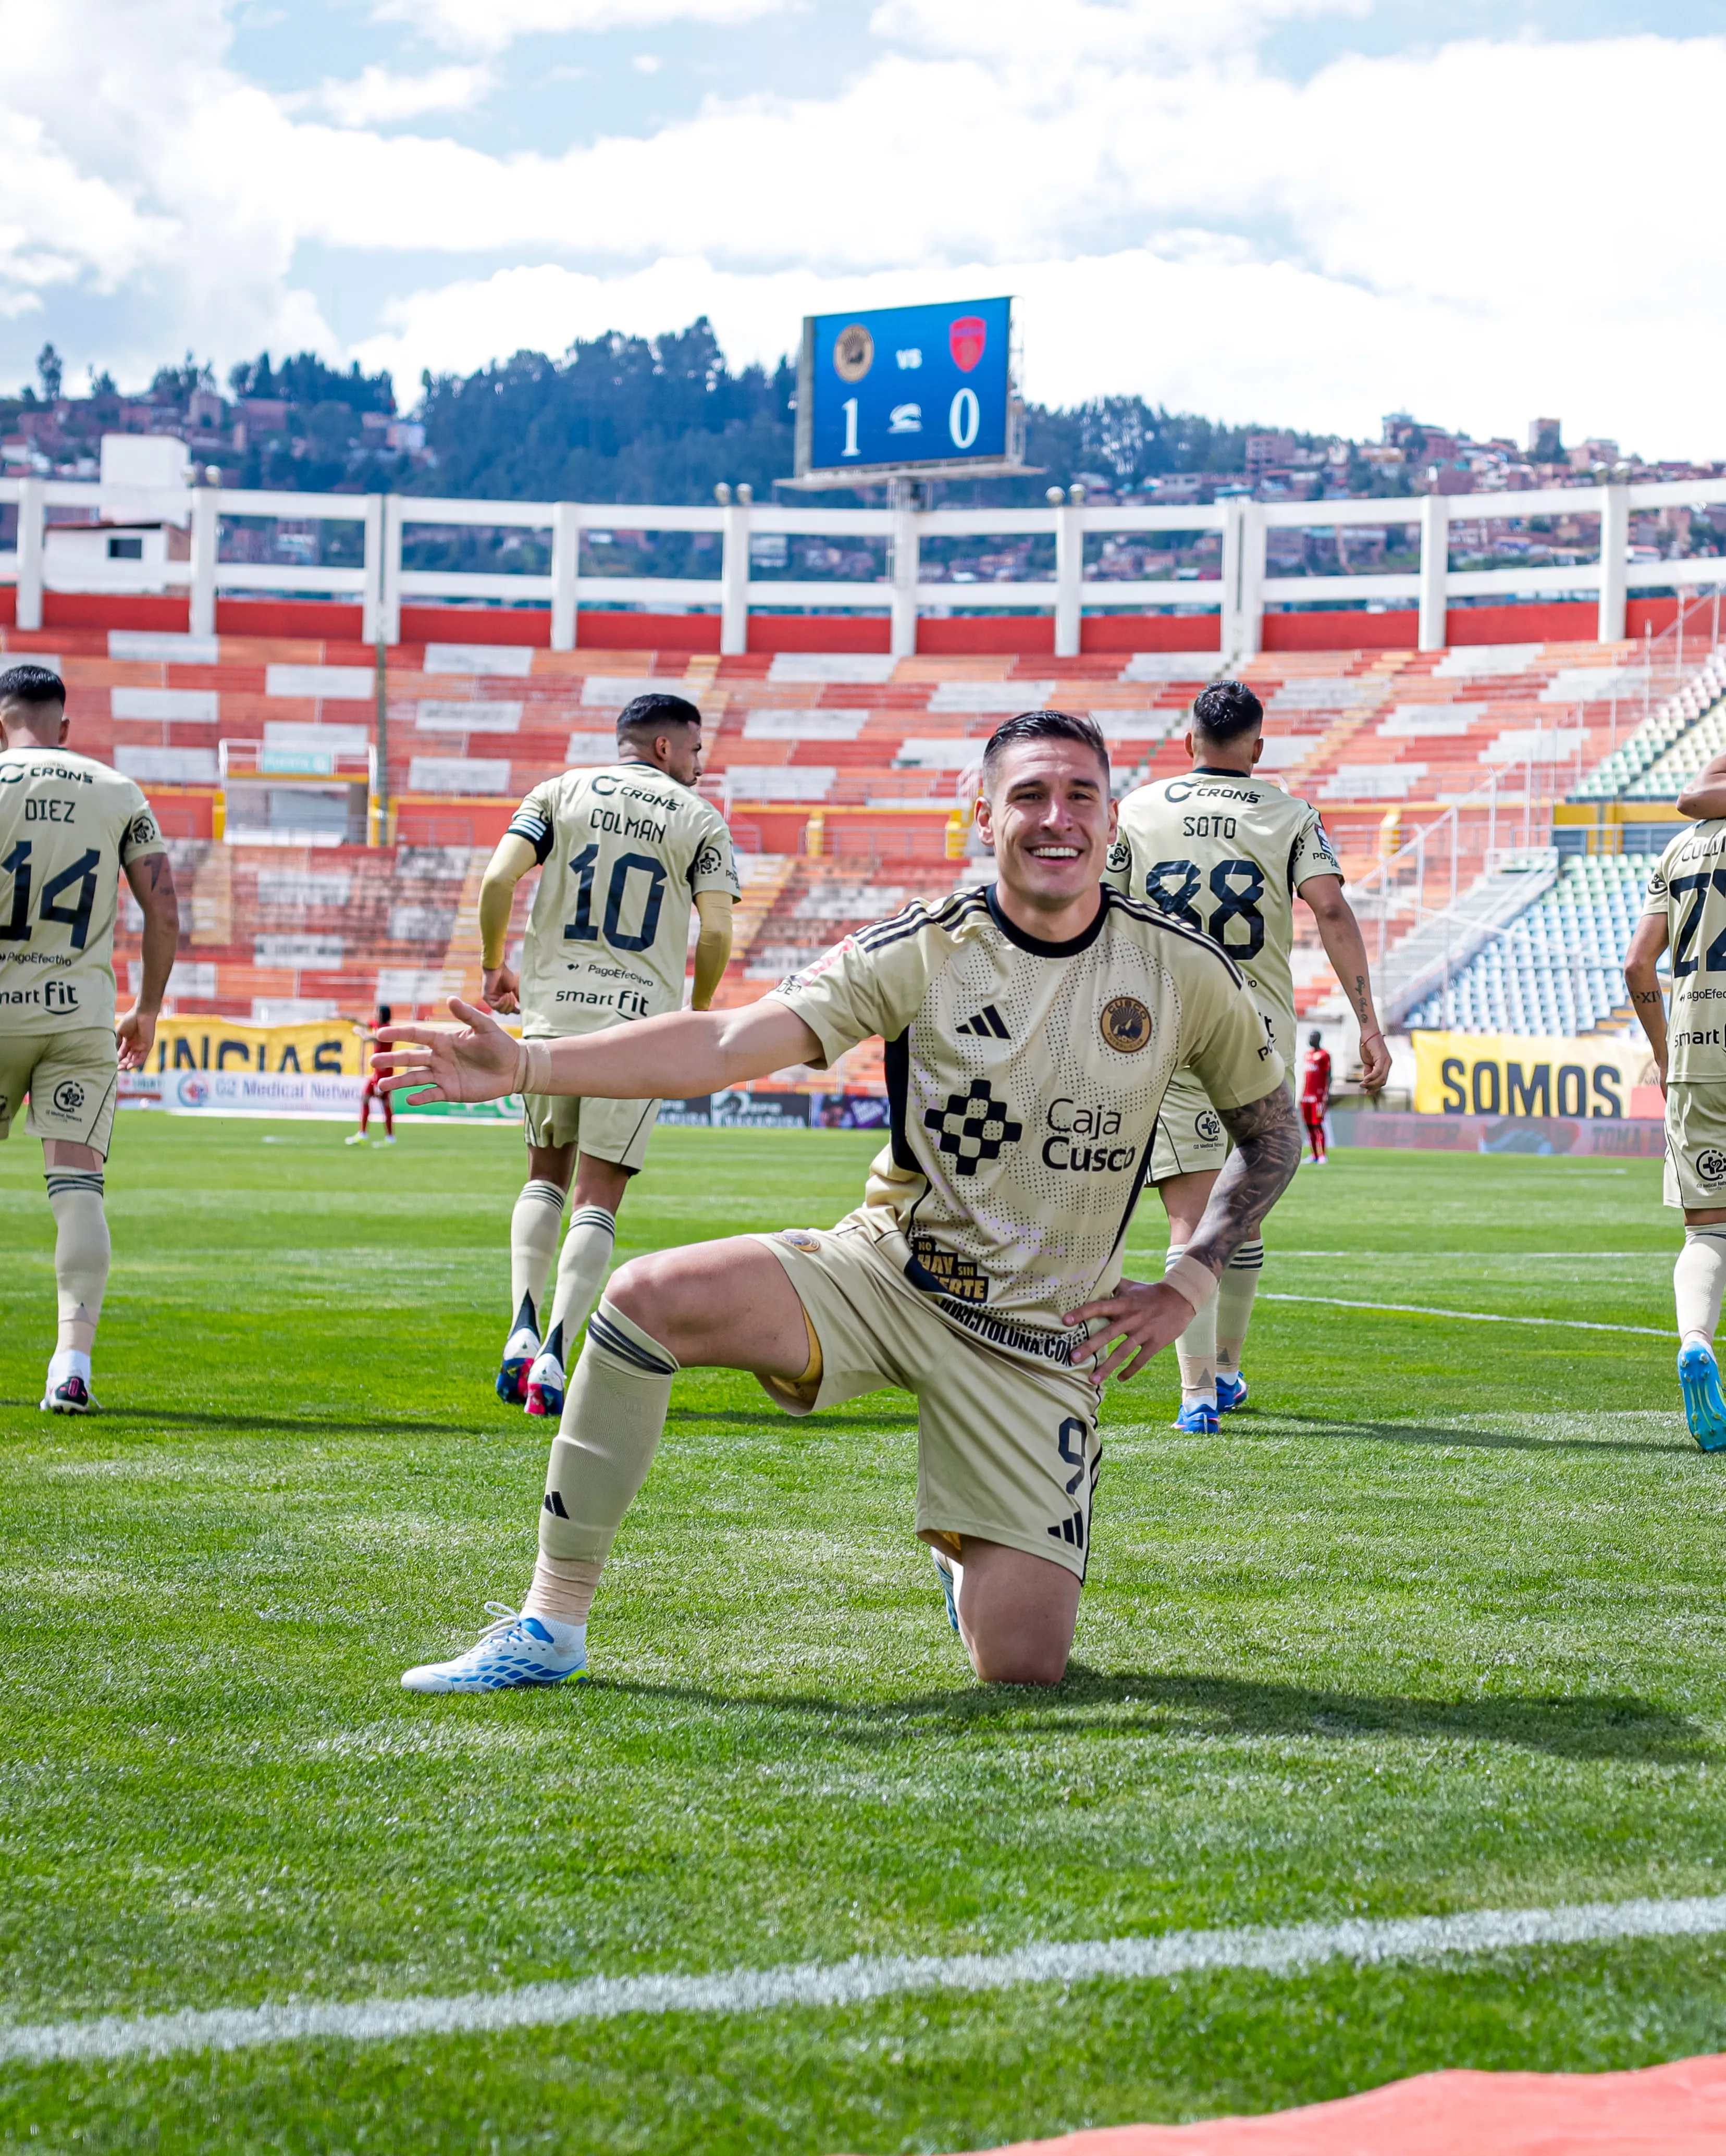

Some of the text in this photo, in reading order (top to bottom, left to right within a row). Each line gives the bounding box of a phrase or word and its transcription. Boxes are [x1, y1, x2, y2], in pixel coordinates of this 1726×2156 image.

[841, 397, 861, 457] 1
[949, 388, 980, 449] 0
[25, 798, 76, 824] DIEZ
[590, 808, 667, 844] COLMAN
[1182, 816, 1237, 839] SOTO
[0, 840, 101, 950] 14
[563, 844, 668, 952] 10
[1146, 860, 1265, 960] 88
[44, 981, 78, 1007] fit
[556, 990, 649, 1017] smart fit
[1674, 1029, 1720, 1048] smart
[1442, 1058, 1621, 1118] SOMOS
[1047, 1098, 1121, 1141] Caja
[1042, 1136, 1135, 1172] Cusco
[918, 1241, 932, 1251] NO
[957, 1266, 974, 1276] SIN
[1058, 1416, 1088, 1495] 9
